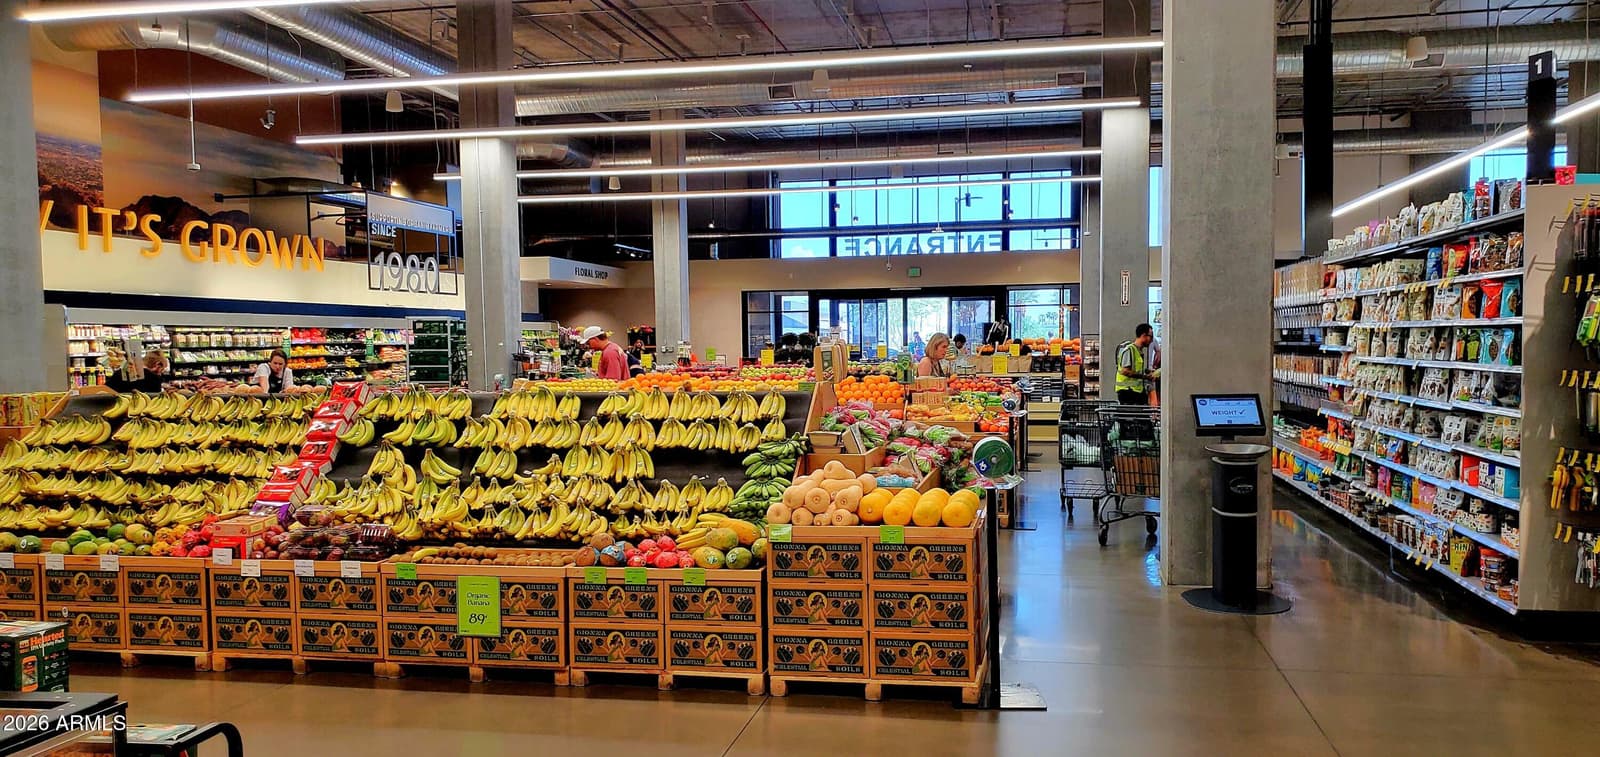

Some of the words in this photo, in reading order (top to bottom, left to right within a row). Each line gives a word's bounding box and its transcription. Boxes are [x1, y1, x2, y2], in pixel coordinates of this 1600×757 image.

[1535, 58, 1543, 74] 1
[372, 223, 397, 237] SINCE
[180, 221, 325, 272] GROWN
[374, 251, 438, 294] 1980
[595, 270, 608, 280] SHOP
